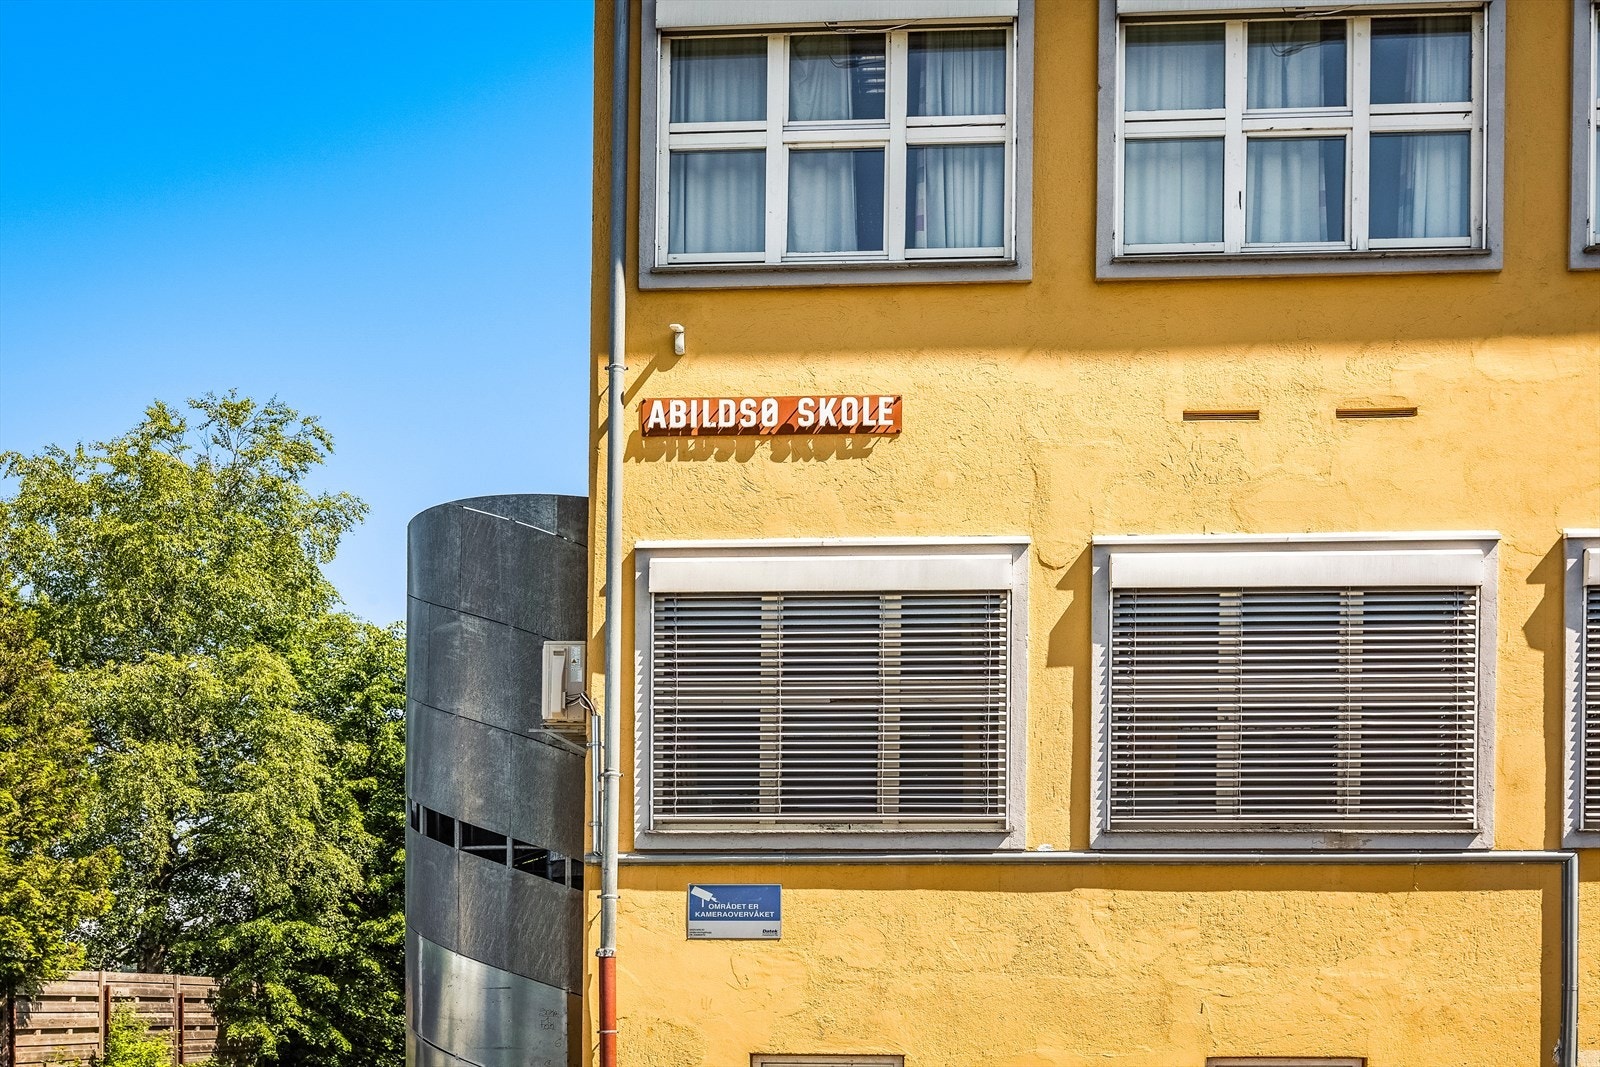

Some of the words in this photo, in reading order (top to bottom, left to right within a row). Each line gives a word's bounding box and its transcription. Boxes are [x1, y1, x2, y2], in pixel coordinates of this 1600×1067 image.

[648, 397, 779, 429] ABILDSØ
[797, 396, 895, 428] SKOLE
[708, 902, 746, 910] OMRÅDET
[694, 910, 775, 918] KAMERAOVERVÅKET
